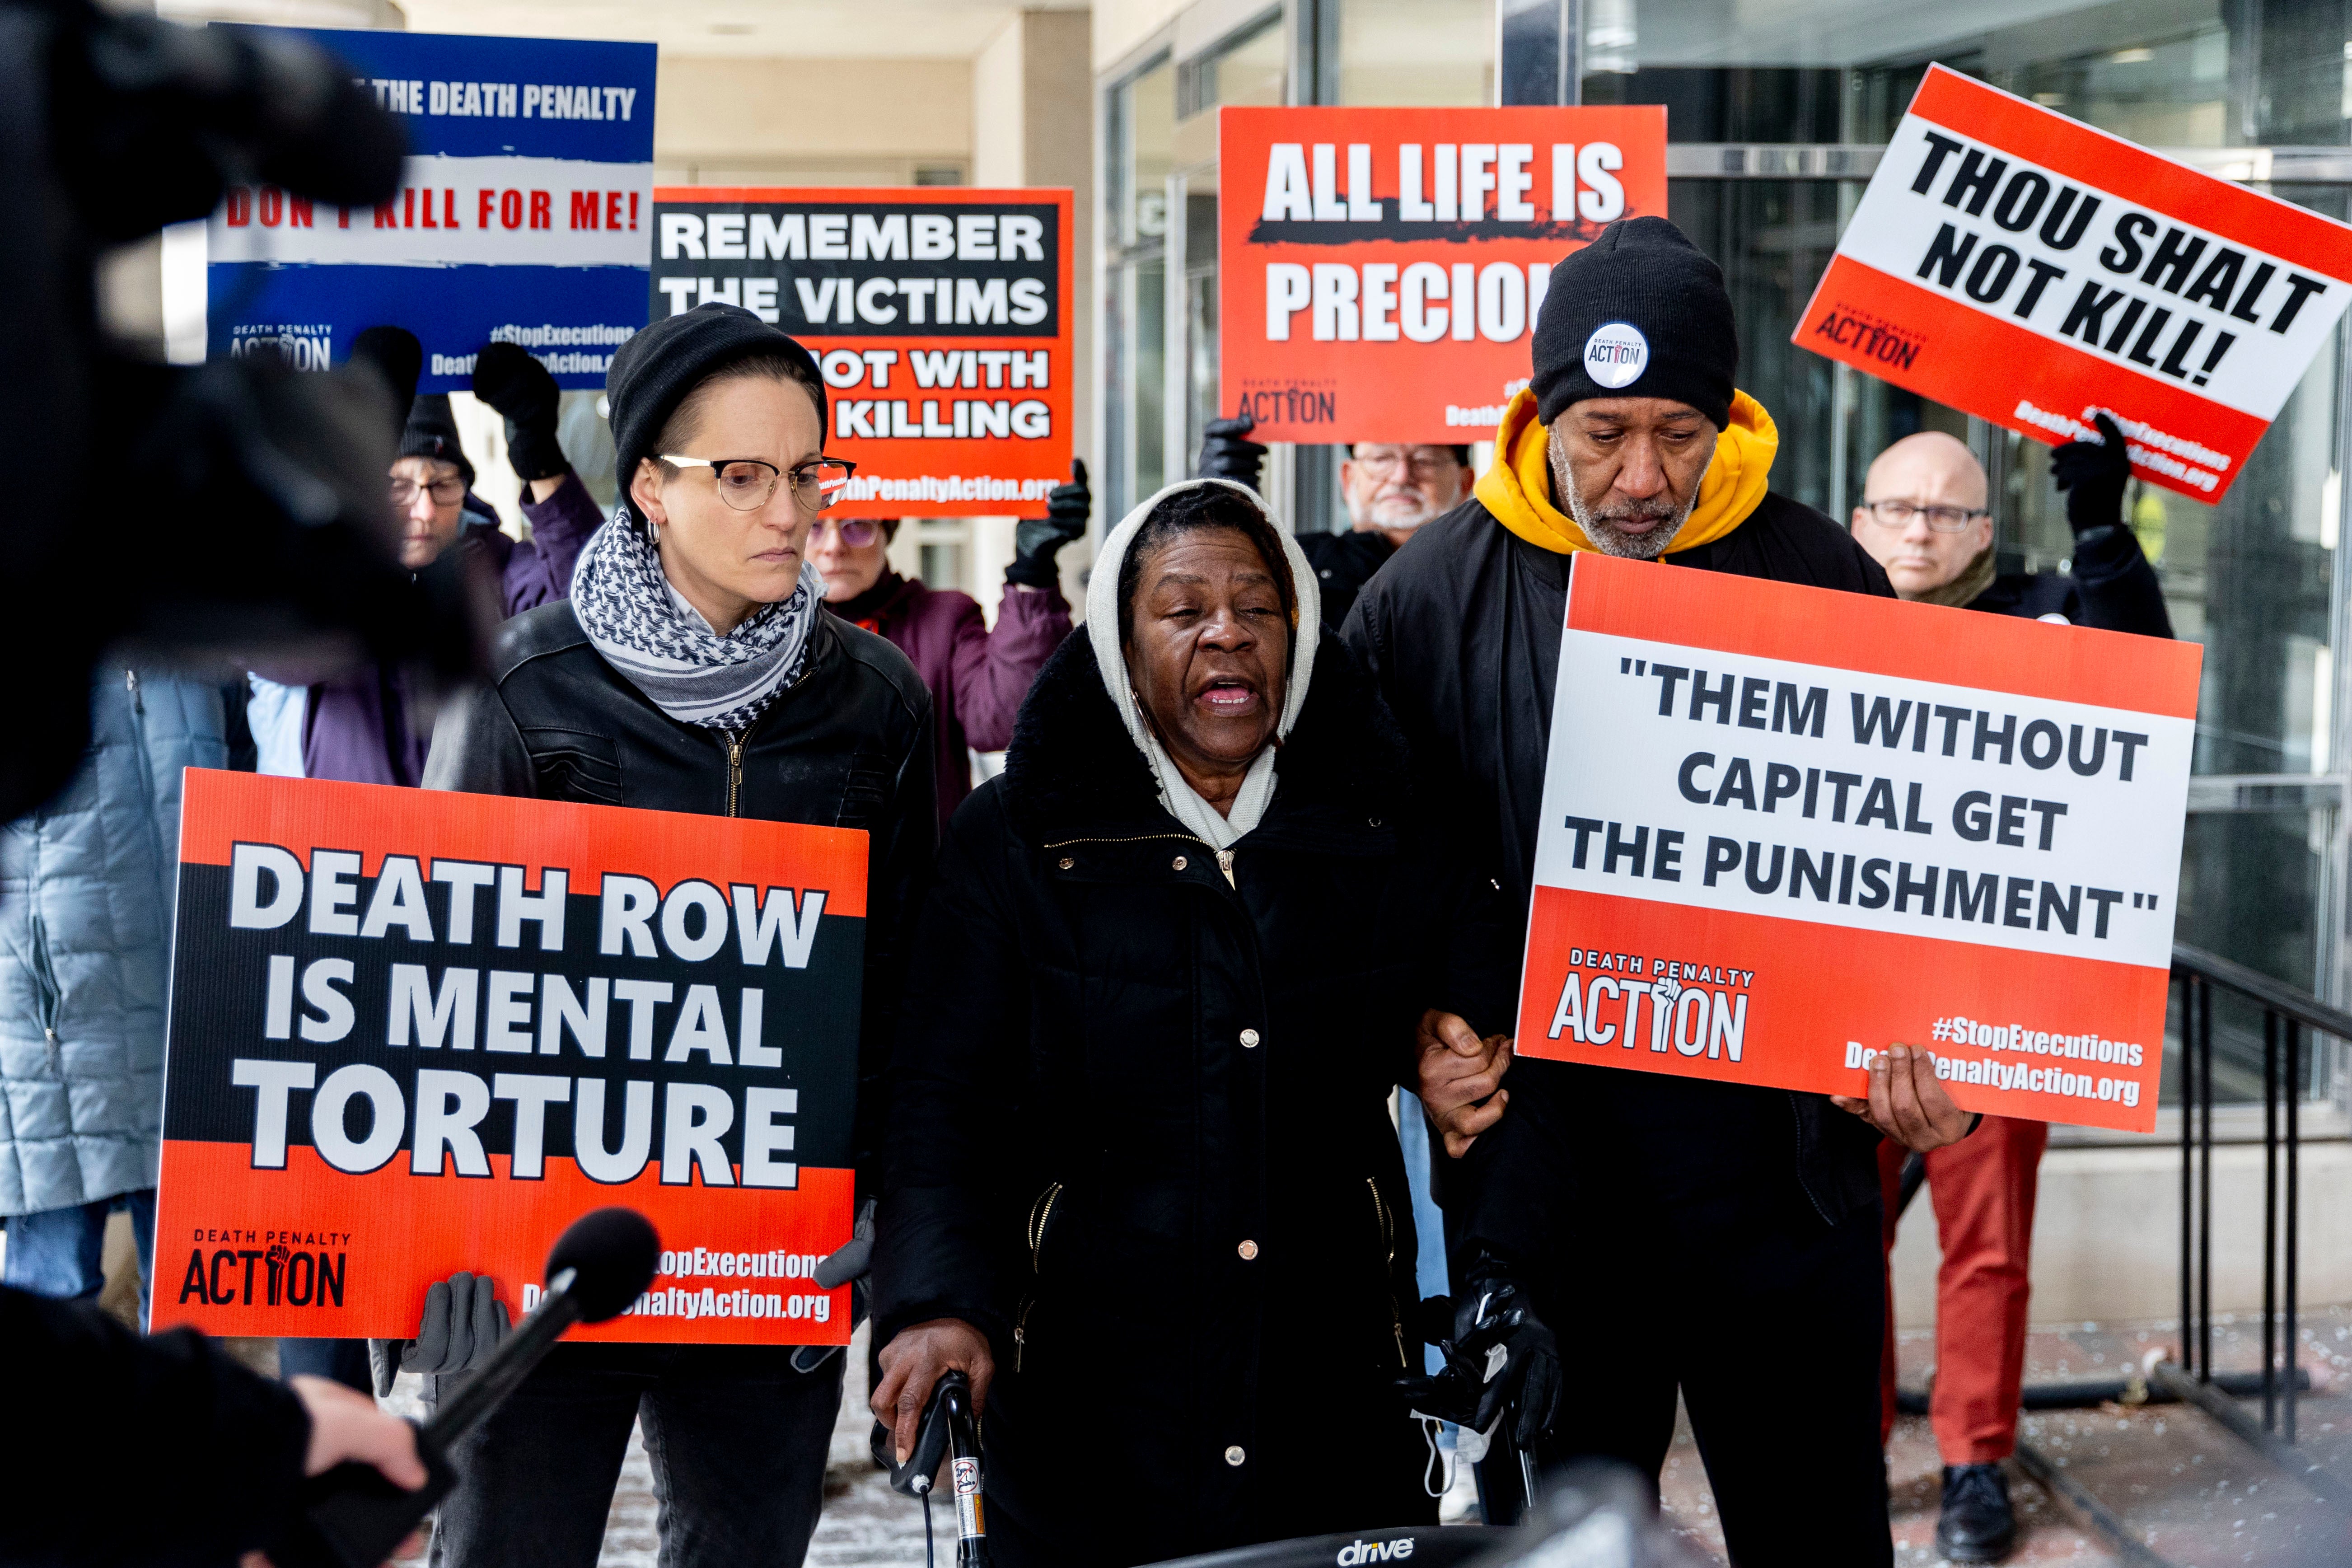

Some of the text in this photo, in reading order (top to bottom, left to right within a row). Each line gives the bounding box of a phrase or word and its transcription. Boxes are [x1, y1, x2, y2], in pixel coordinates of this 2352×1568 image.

[372, 79, 636, 121] THE DEATH PENALTY
[1263, 141, 1625, 223] ALL LIFE IS
[227, 186, 350, 229] DON
[479, 189, 550, 229] FOR
[570, 191, 639, 230] ME!
[660, 213, 1045, 261] REMEMBER
[1910, 131, 2327, 335] THOU SHALT
[659, 277, 1048, 325] THE VICTIMS
[1267, 262, 1557, 342] PRECIO
[1917, 222, 2237, 387] NOT KILL!
[230, 336, 331, 372] ACION
[233, 324, 332, 336] DEATH PENALTY
[1816, 312, 1921, 372] ACTION
[909, 350, 1049, 388] WITH
[1588, 344, 1640, 365] ACTION
[836, 399, 1050, 439] KILLING
[1238, 387, 1335, 423] ACTION
[839, 475, 1060, 504] thPenaltyAction.or
[1620, 657, 2149, 782] "THEM WITHOUT
[1677, 752, 2068, 851] CAPITAL GET
[1564, 815, 2159, 940] THE PUNISHMENT"
[229, 841, 828, 969] DEATH ROW
[1570, 947, 1754, 988] DEATH PENALTY
[264, 955, 783, 1068] IS MENTAL
[1547, 971, 1748, 1062] ACTION
[1932, 1016, 2143, 1068] #StopExecutions
[1845, 1041, 2140, 1107] DeenaltyAction.org
[231, 1058, 800, 1189] TORTURE
[194, 1229, 351, 1246] DEATH PENALTY
[178, 1245, 346, 1307] ACTION
[653, 1247, 828, 1279] opExecution
[523, 1283, 830, 1323] DnaltyAction.org
[1337, 1539, 1413, 1567] drive
